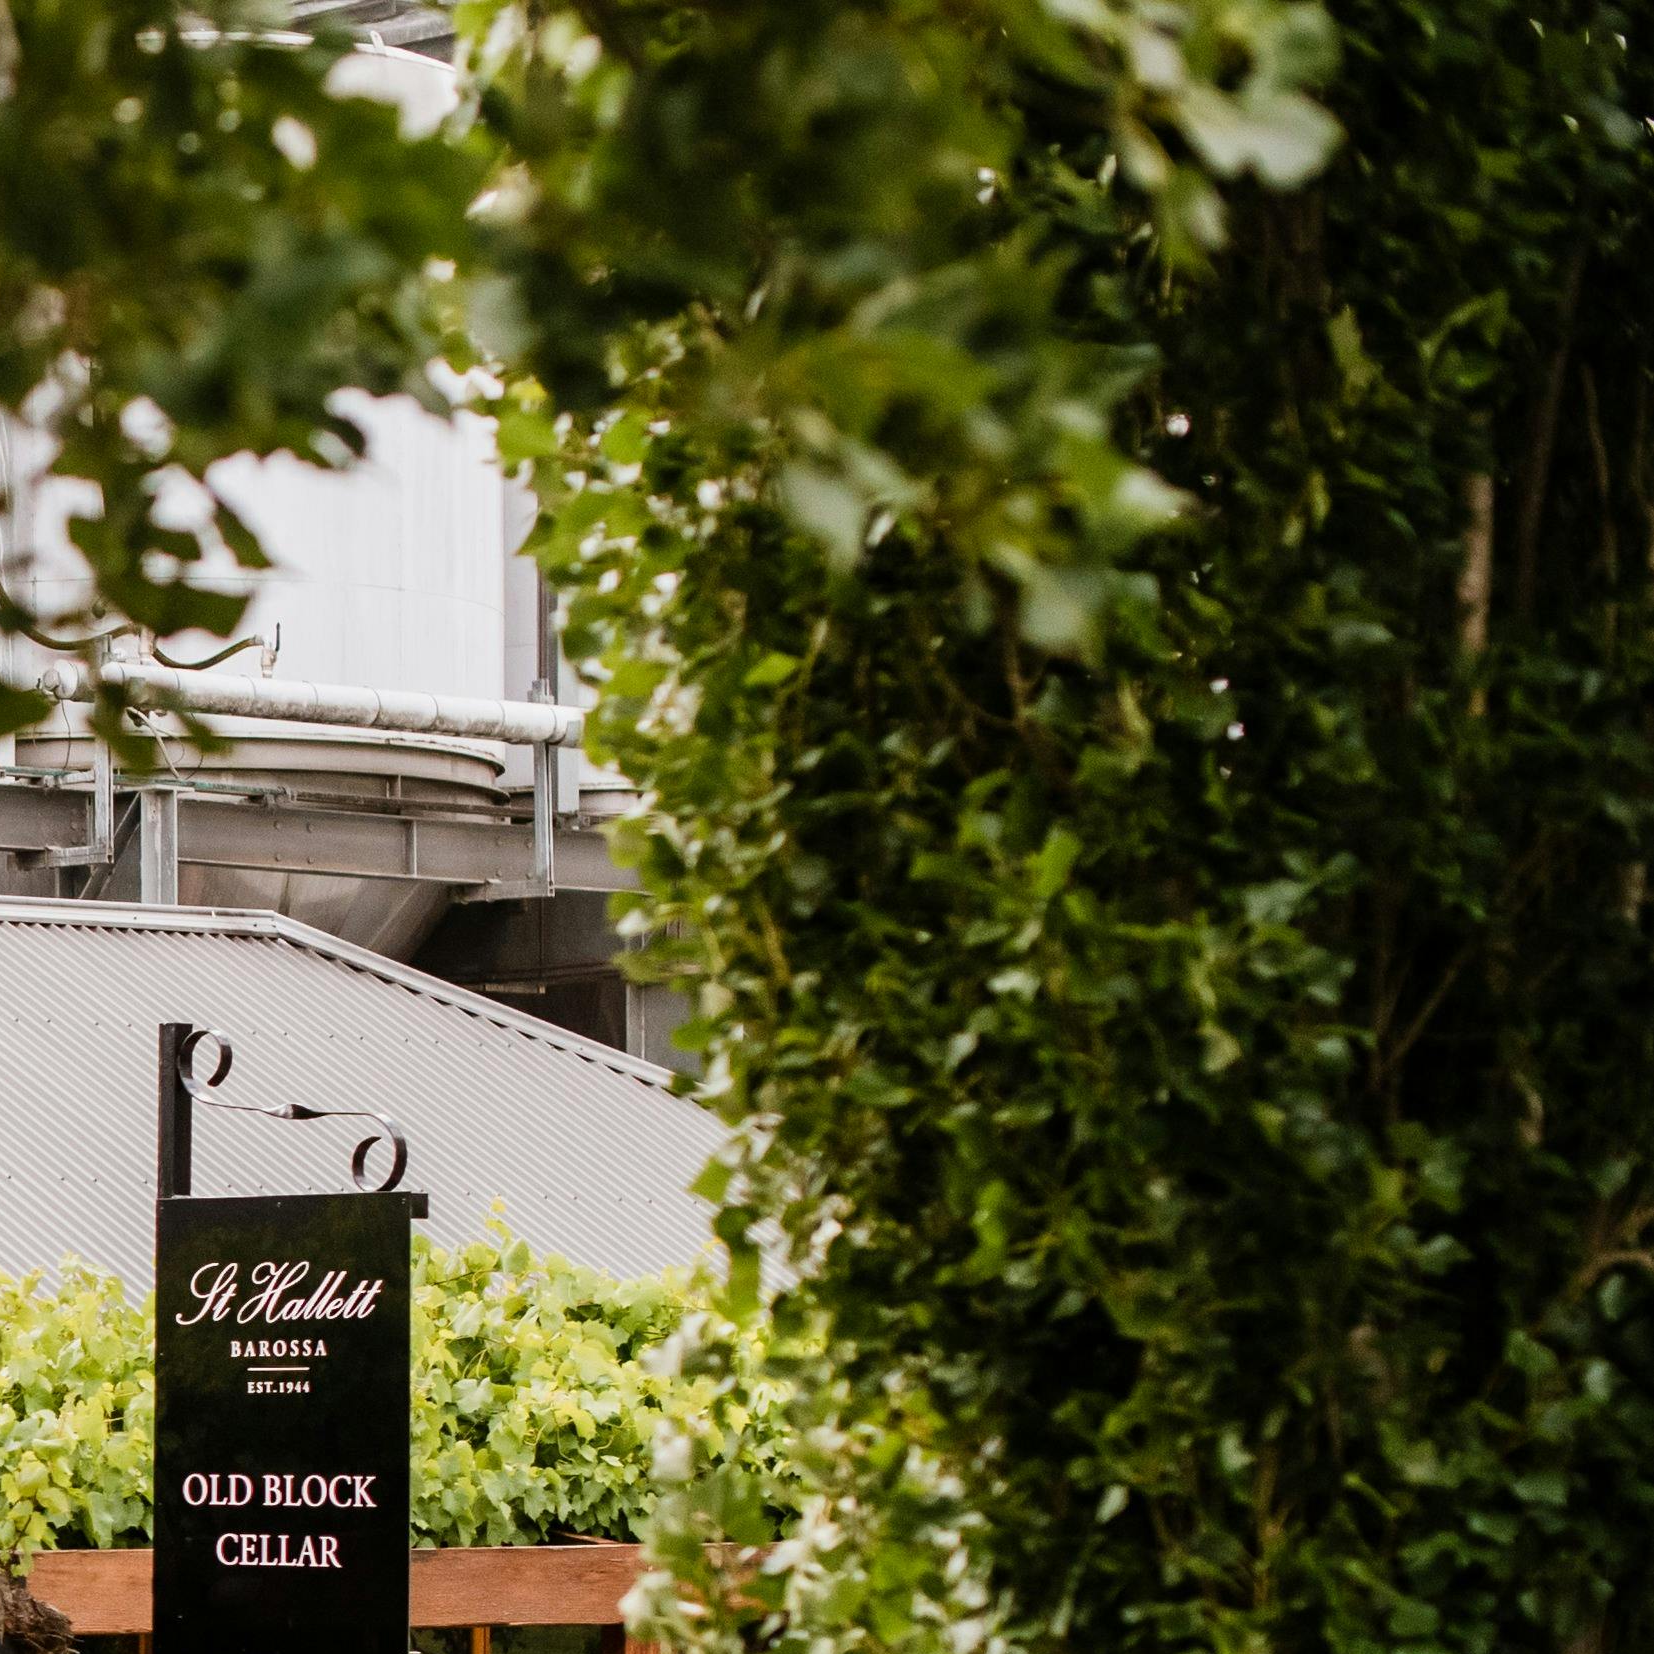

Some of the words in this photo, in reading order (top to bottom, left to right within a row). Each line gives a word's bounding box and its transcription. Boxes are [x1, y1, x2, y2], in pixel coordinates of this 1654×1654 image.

[175, 1262, 238, 1326] St
[236, 1261, 383, 1324] Hallett
[230, 1339, 327, 1357] BAROSSA
[182, 1473, 253, 1506] OLD
[262, 1474, 377, 1507] BLOCK
[216, 1532, 342, 1568] CELLAR
